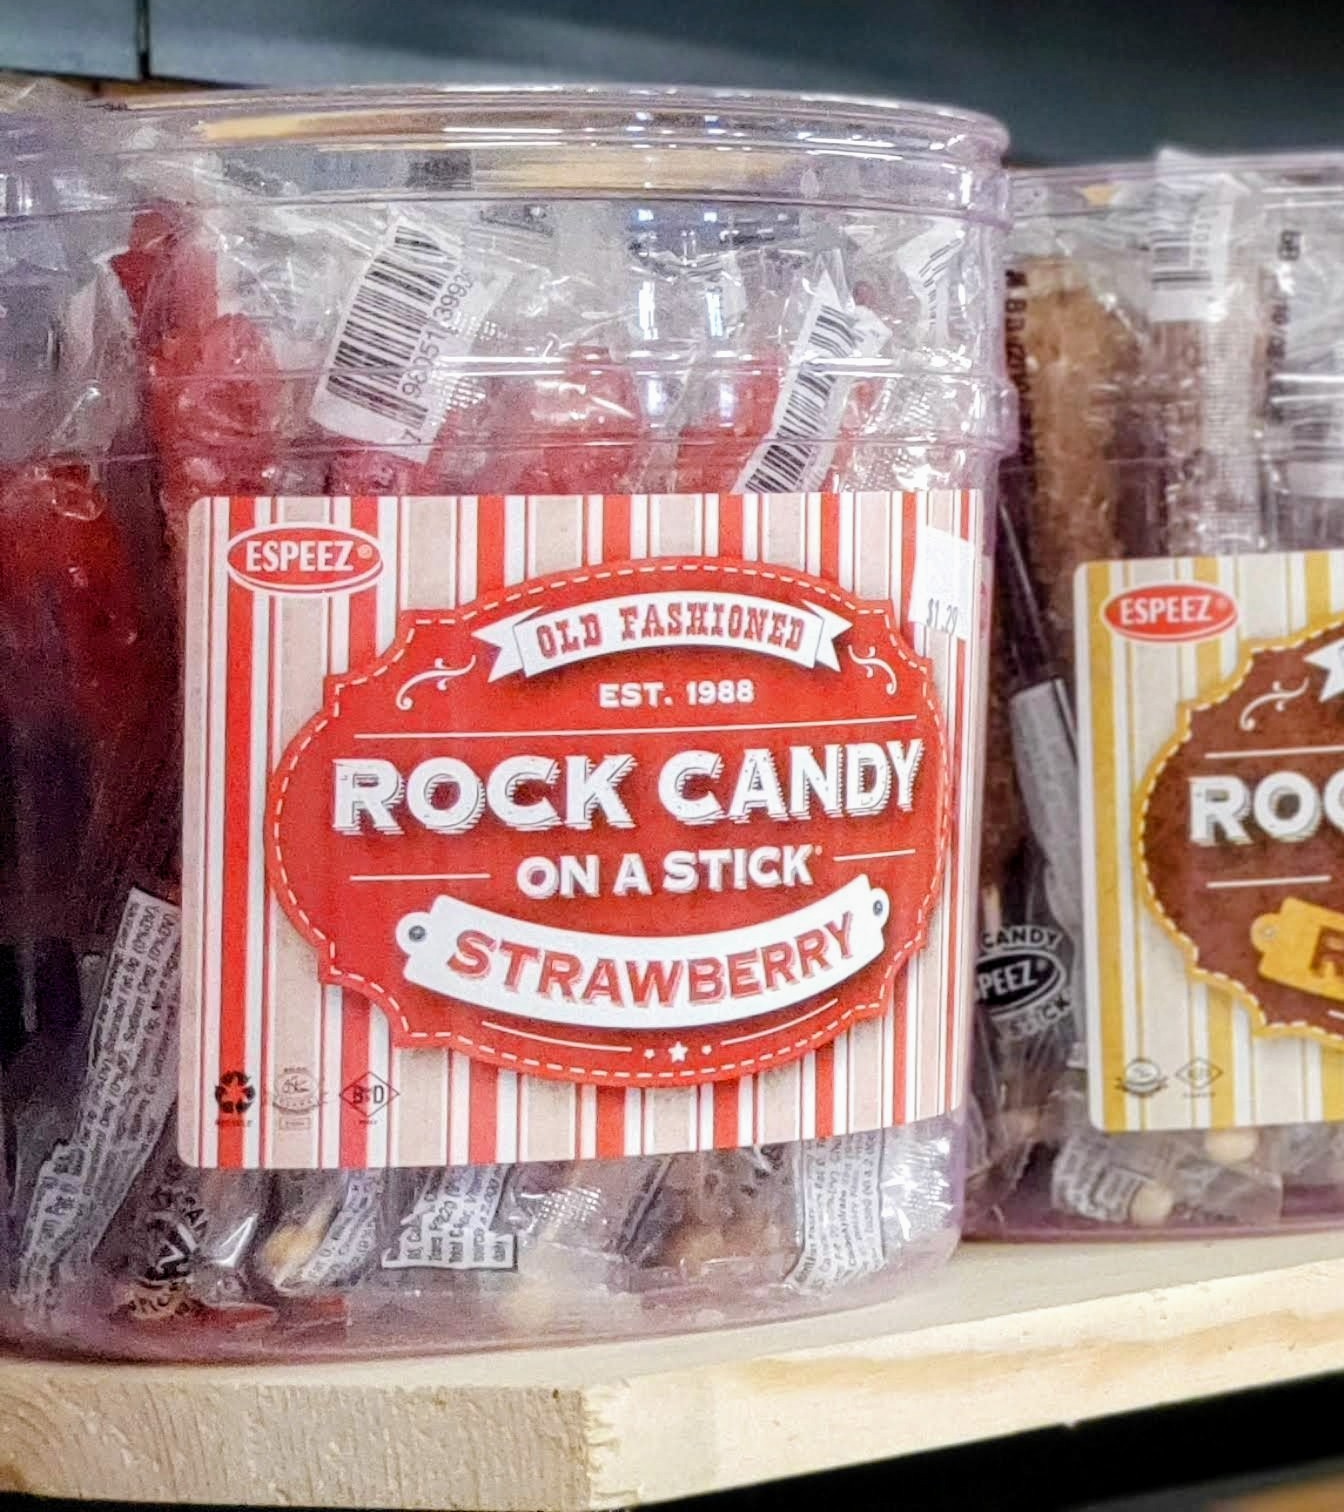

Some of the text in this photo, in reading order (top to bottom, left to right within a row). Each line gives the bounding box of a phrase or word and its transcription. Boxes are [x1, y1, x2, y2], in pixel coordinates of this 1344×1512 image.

[246, 540, 355, 572] ESPEEZ
[535, 601, 806, 660] OLD FASHIONED
[1119, 594, 1213, 626] ESPEEZ
[599, 678, 756, 709] EST. 1988
[331, 738, 926, 837] ROCK CANDY
[516, 844, 815, 900] ON A STICK
[446, 909, 854, 1009] STRAWBERRY
[982, 927, 1061, 949] CANDY
[978, 958, 1039, 1001] PEEZ
